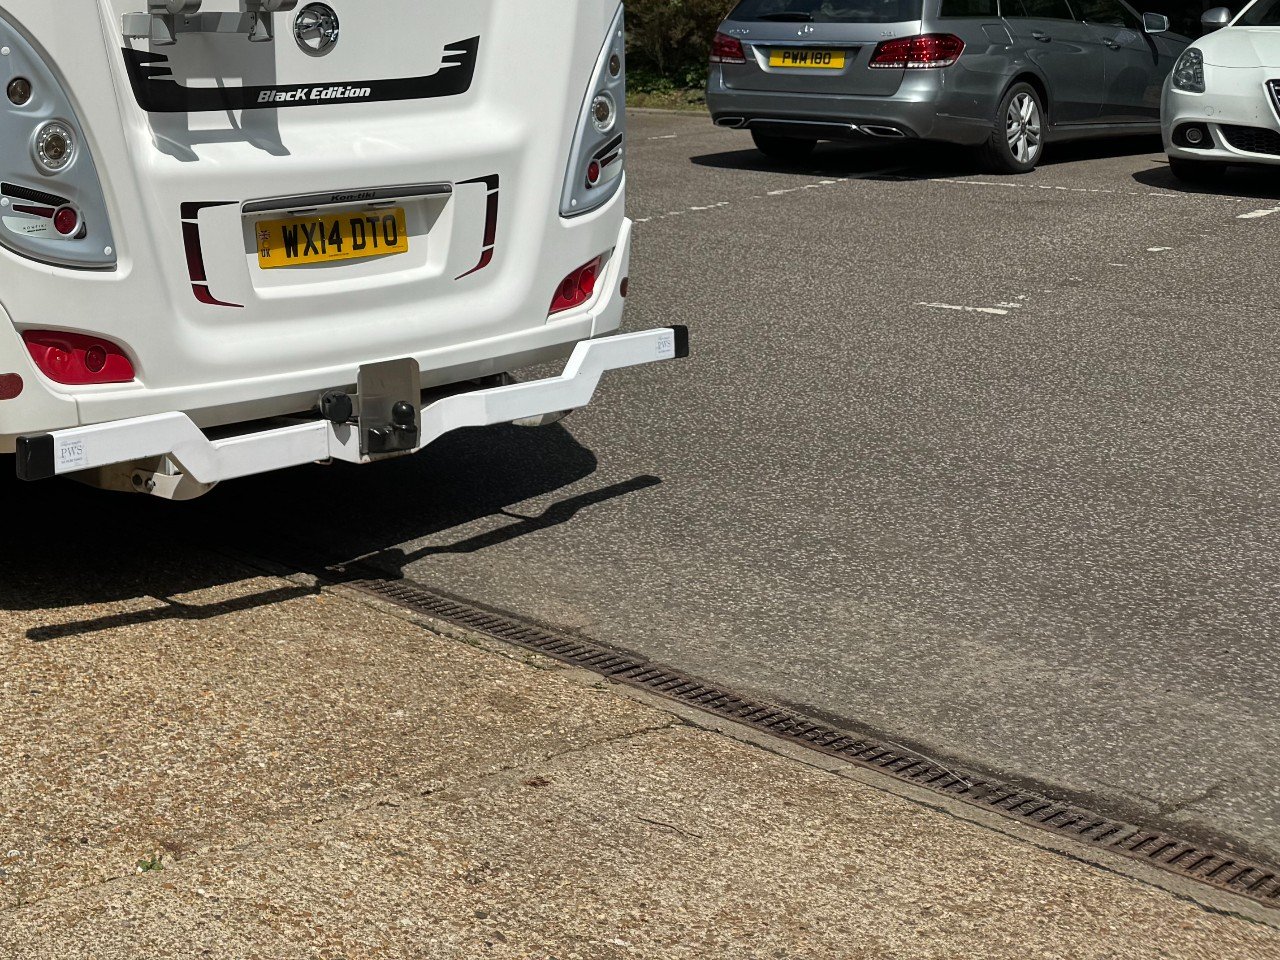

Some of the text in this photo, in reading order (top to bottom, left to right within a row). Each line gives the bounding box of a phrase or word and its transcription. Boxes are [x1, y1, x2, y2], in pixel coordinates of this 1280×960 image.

[310, 86, 371, 100] Edition
[331, 192, 376, 201] Kon-tiki
[282, 215, 398, 259] WX14 DTO
[261, 248, 271, 258] UK
[61, 444, 83, 458] PWS
